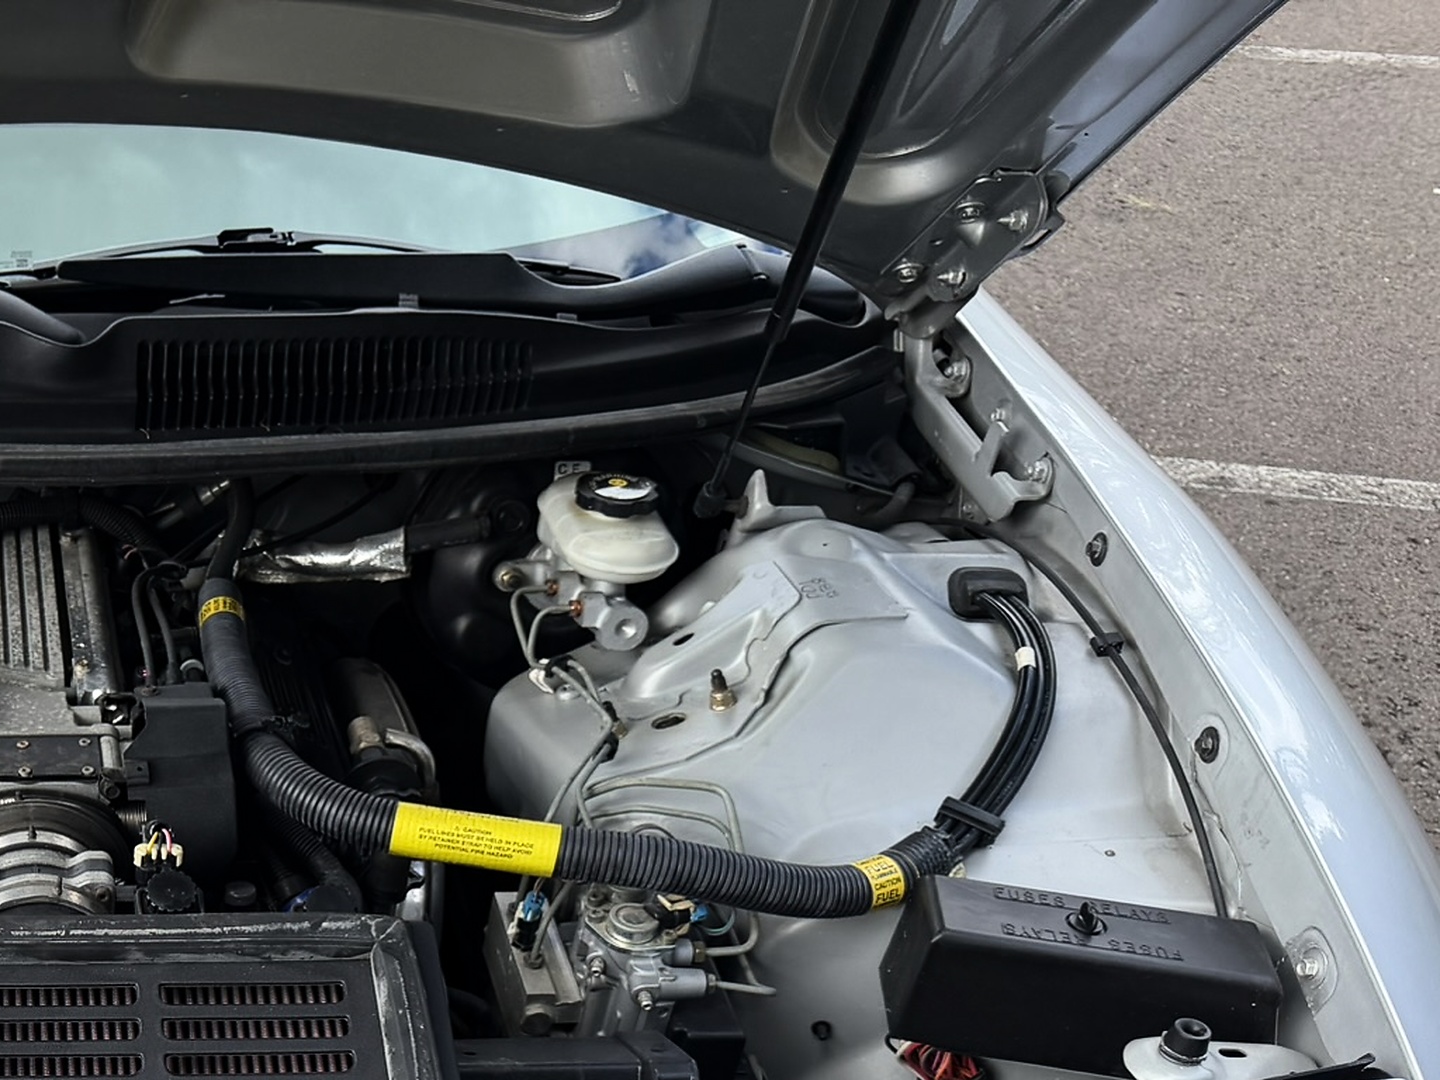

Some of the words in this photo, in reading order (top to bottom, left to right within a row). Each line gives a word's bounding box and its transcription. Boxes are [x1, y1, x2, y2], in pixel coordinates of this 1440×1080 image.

[463, 828, 492, 836] CAUTION
[456, 832, 475, 840] MUST
[512, 841, 534, 849] PLACE
[434, 843, 469, 853] POTENTIAL
[470, 848, 485, 856] FIRE
[486, 851, 513, 859] HAZARD
[512, 848, 533, 856] AVOID
[875, 888, 901, 904] FUEL
[993, 886, 1066, 908] FUSES
[1107, 938, 1184, 962] FUSES
